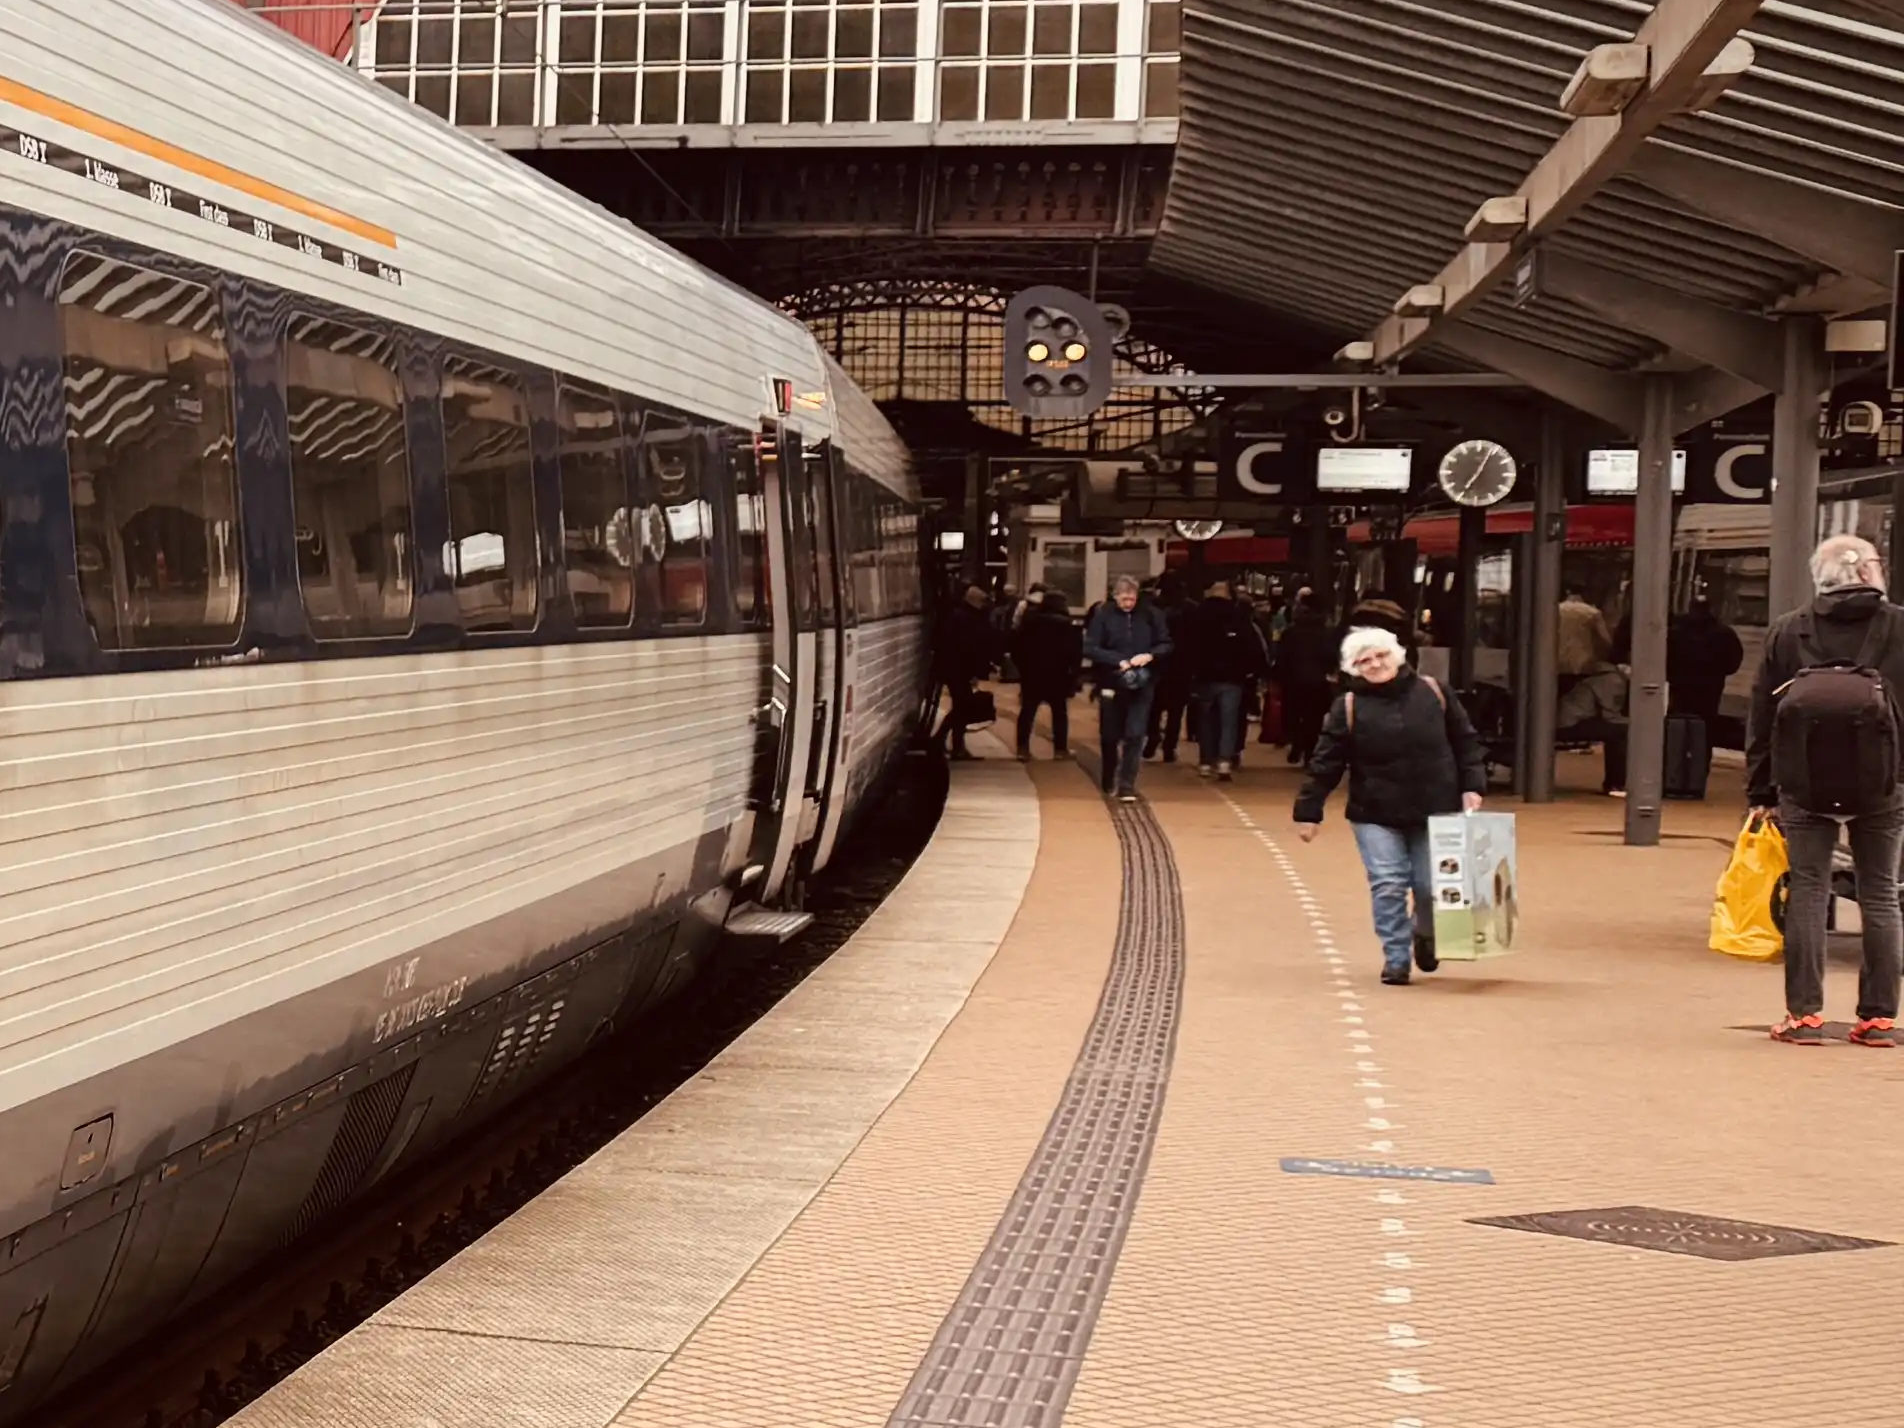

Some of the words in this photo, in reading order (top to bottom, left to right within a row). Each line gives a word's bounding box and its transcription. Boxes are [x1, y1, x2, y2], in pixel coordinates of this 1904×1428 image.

[19, 134, 39, 160] DSB
[1236, 441, 1283, 494] C
[1714, 444, 1766, 499] C
